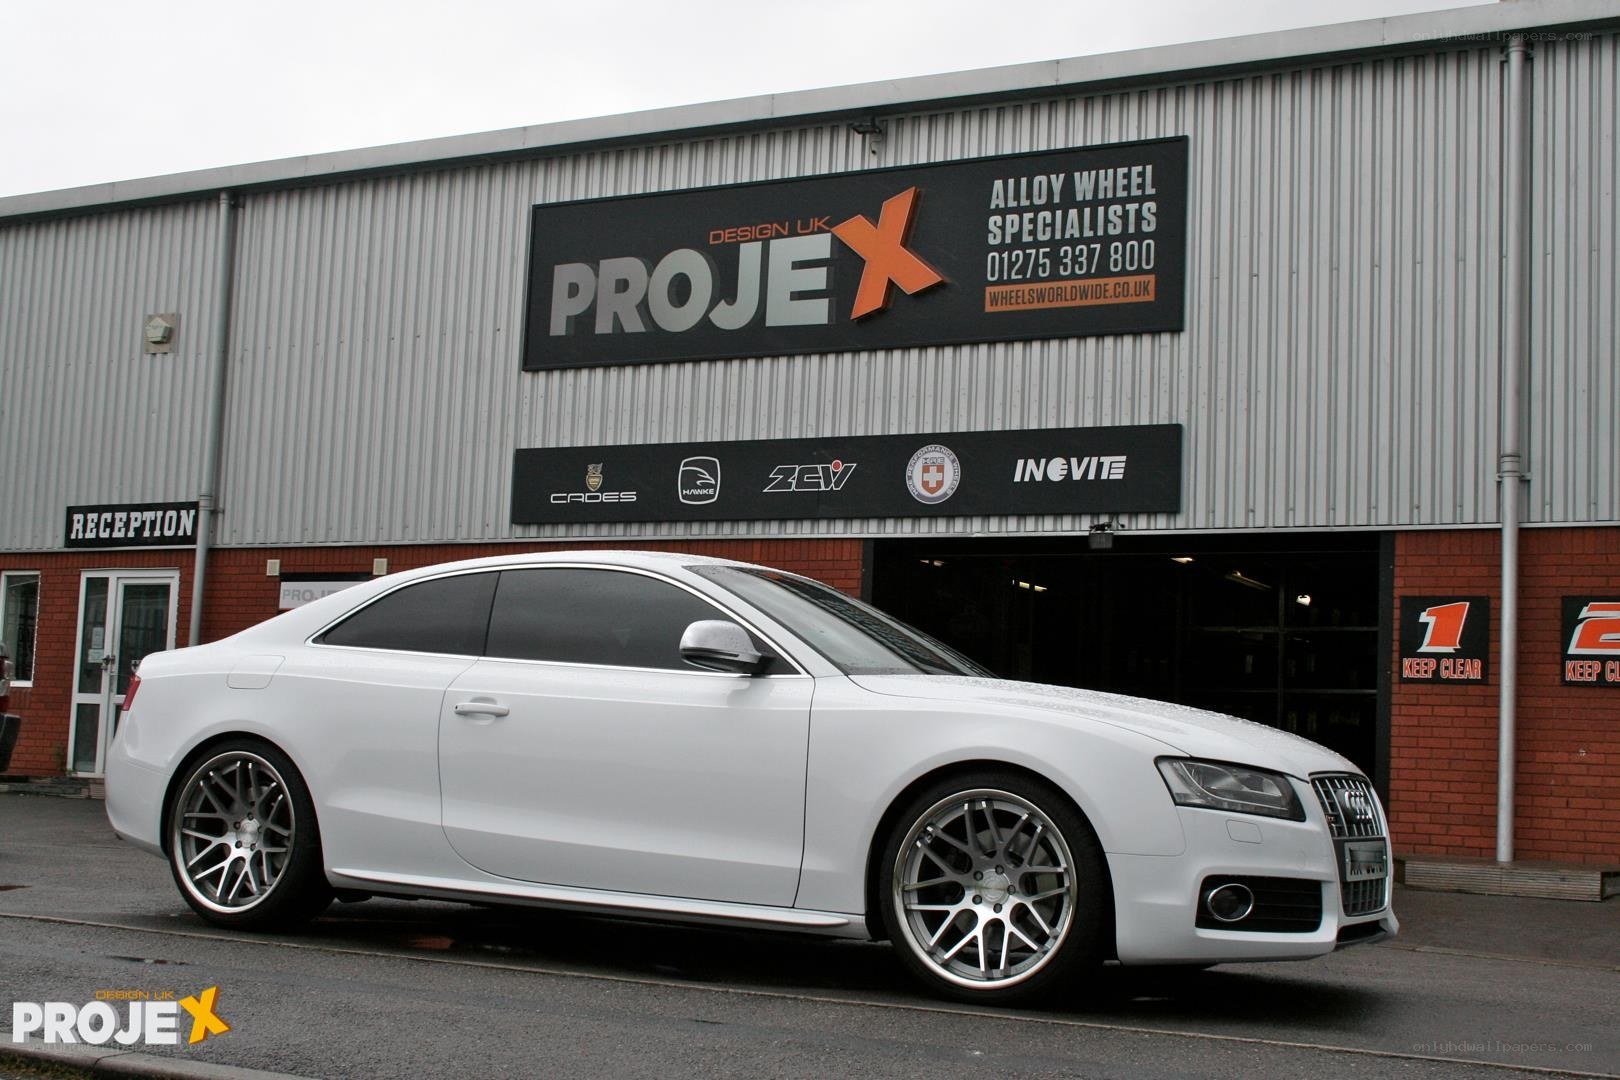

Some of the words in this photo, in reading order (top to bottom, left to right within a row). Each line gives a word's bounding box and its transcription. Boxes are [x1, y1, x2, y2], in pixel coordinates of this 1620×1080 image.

[990, 172, 1065, 209] ALLOY
[1073, 164, 1156, 202] WHEEL
[709, 221, 789, 245] DESIGN
[796, 215, 832, 234] UK
[987, 201, 1157, 245] SPECIALISTS
[549, 186, 944, 337] PROJEX
[986, 247, 1051, 281] 01275
[1059, 243, 1101, 276] 337
[1109, 239, 1155, 272] 800
[988, 280, 1151, 308] WHEELSWORLDWIDE.CO.UK
[1013, 455, 1127, 482] INOVITE
[550, 491, 637, 504] CADES
[682, 488, 715, 496] HAWKE
[70, 509, 195, 539] RECEPTION
[1416, 602, 1470, 653] 1
[1567, 602, 1620, 655] 2
[1402, 657, 1437, 679] KEEP
[1440, 658, 1482, 680] CLEAR
[1565, 660, 1601, 681] KEEP
